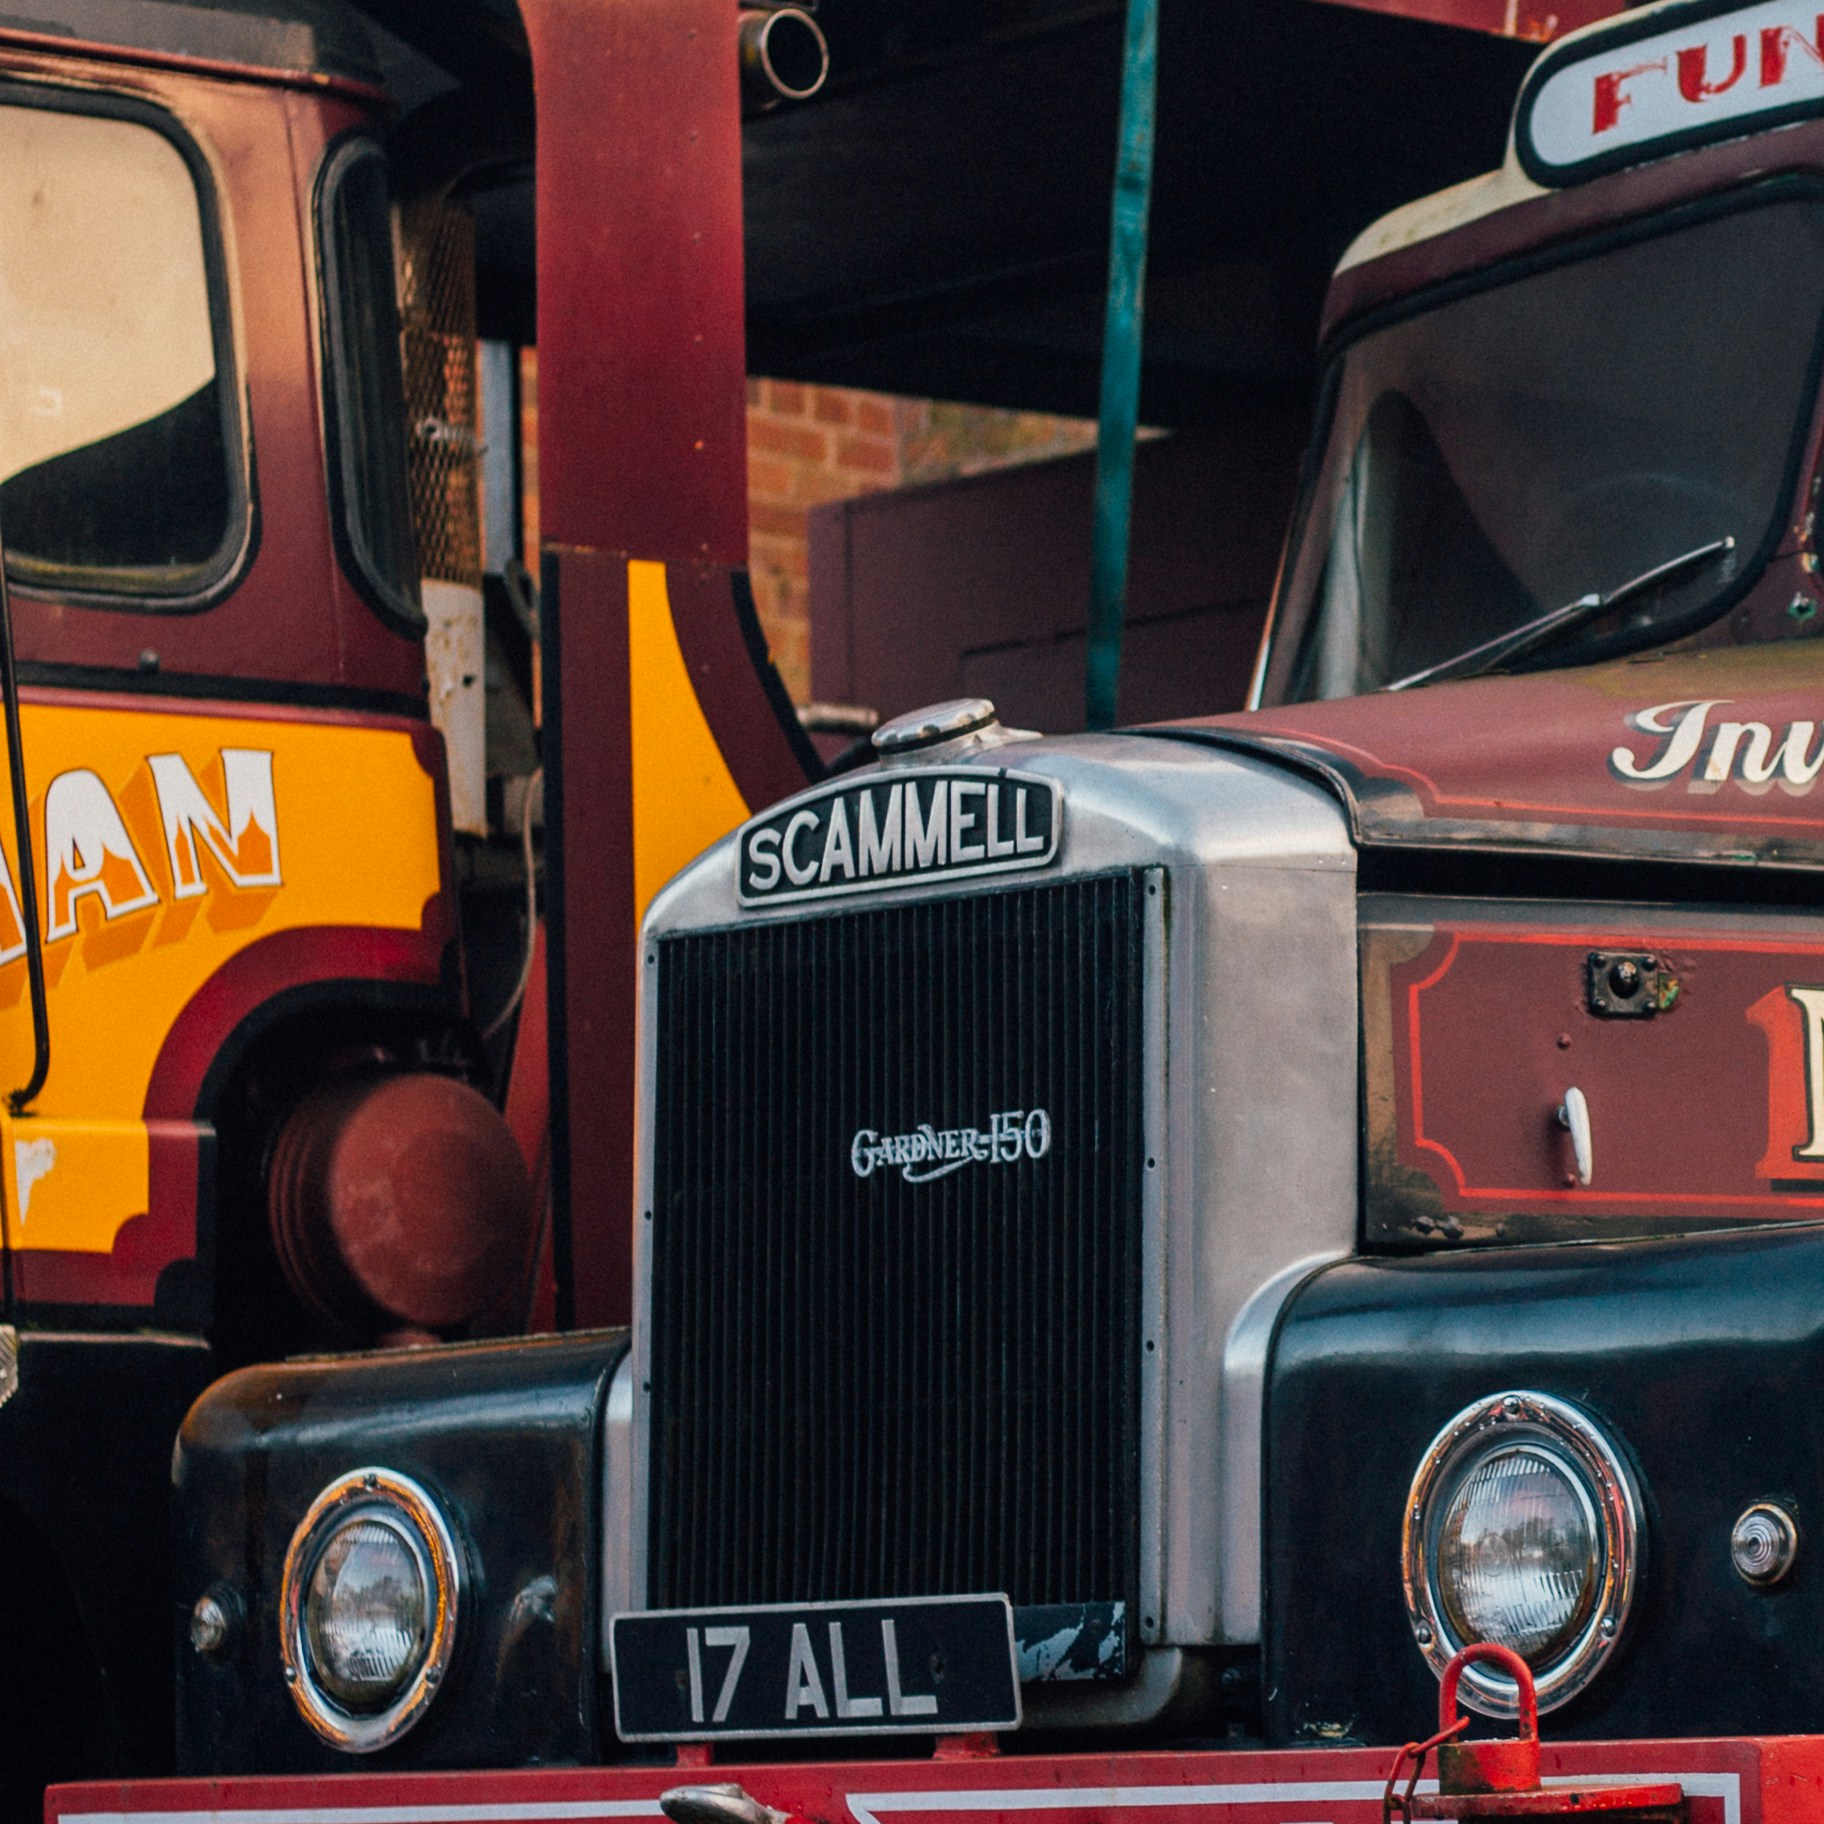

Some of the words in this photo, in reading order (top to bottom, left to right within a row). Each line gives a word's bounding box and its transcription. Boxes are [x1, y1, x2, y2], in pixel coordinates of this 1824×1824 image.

[748, 779, 1046, 891] SCAMMELL
[686, 1625, 752, 1724] 17
[784, 1617, 940, 1722] ALL
